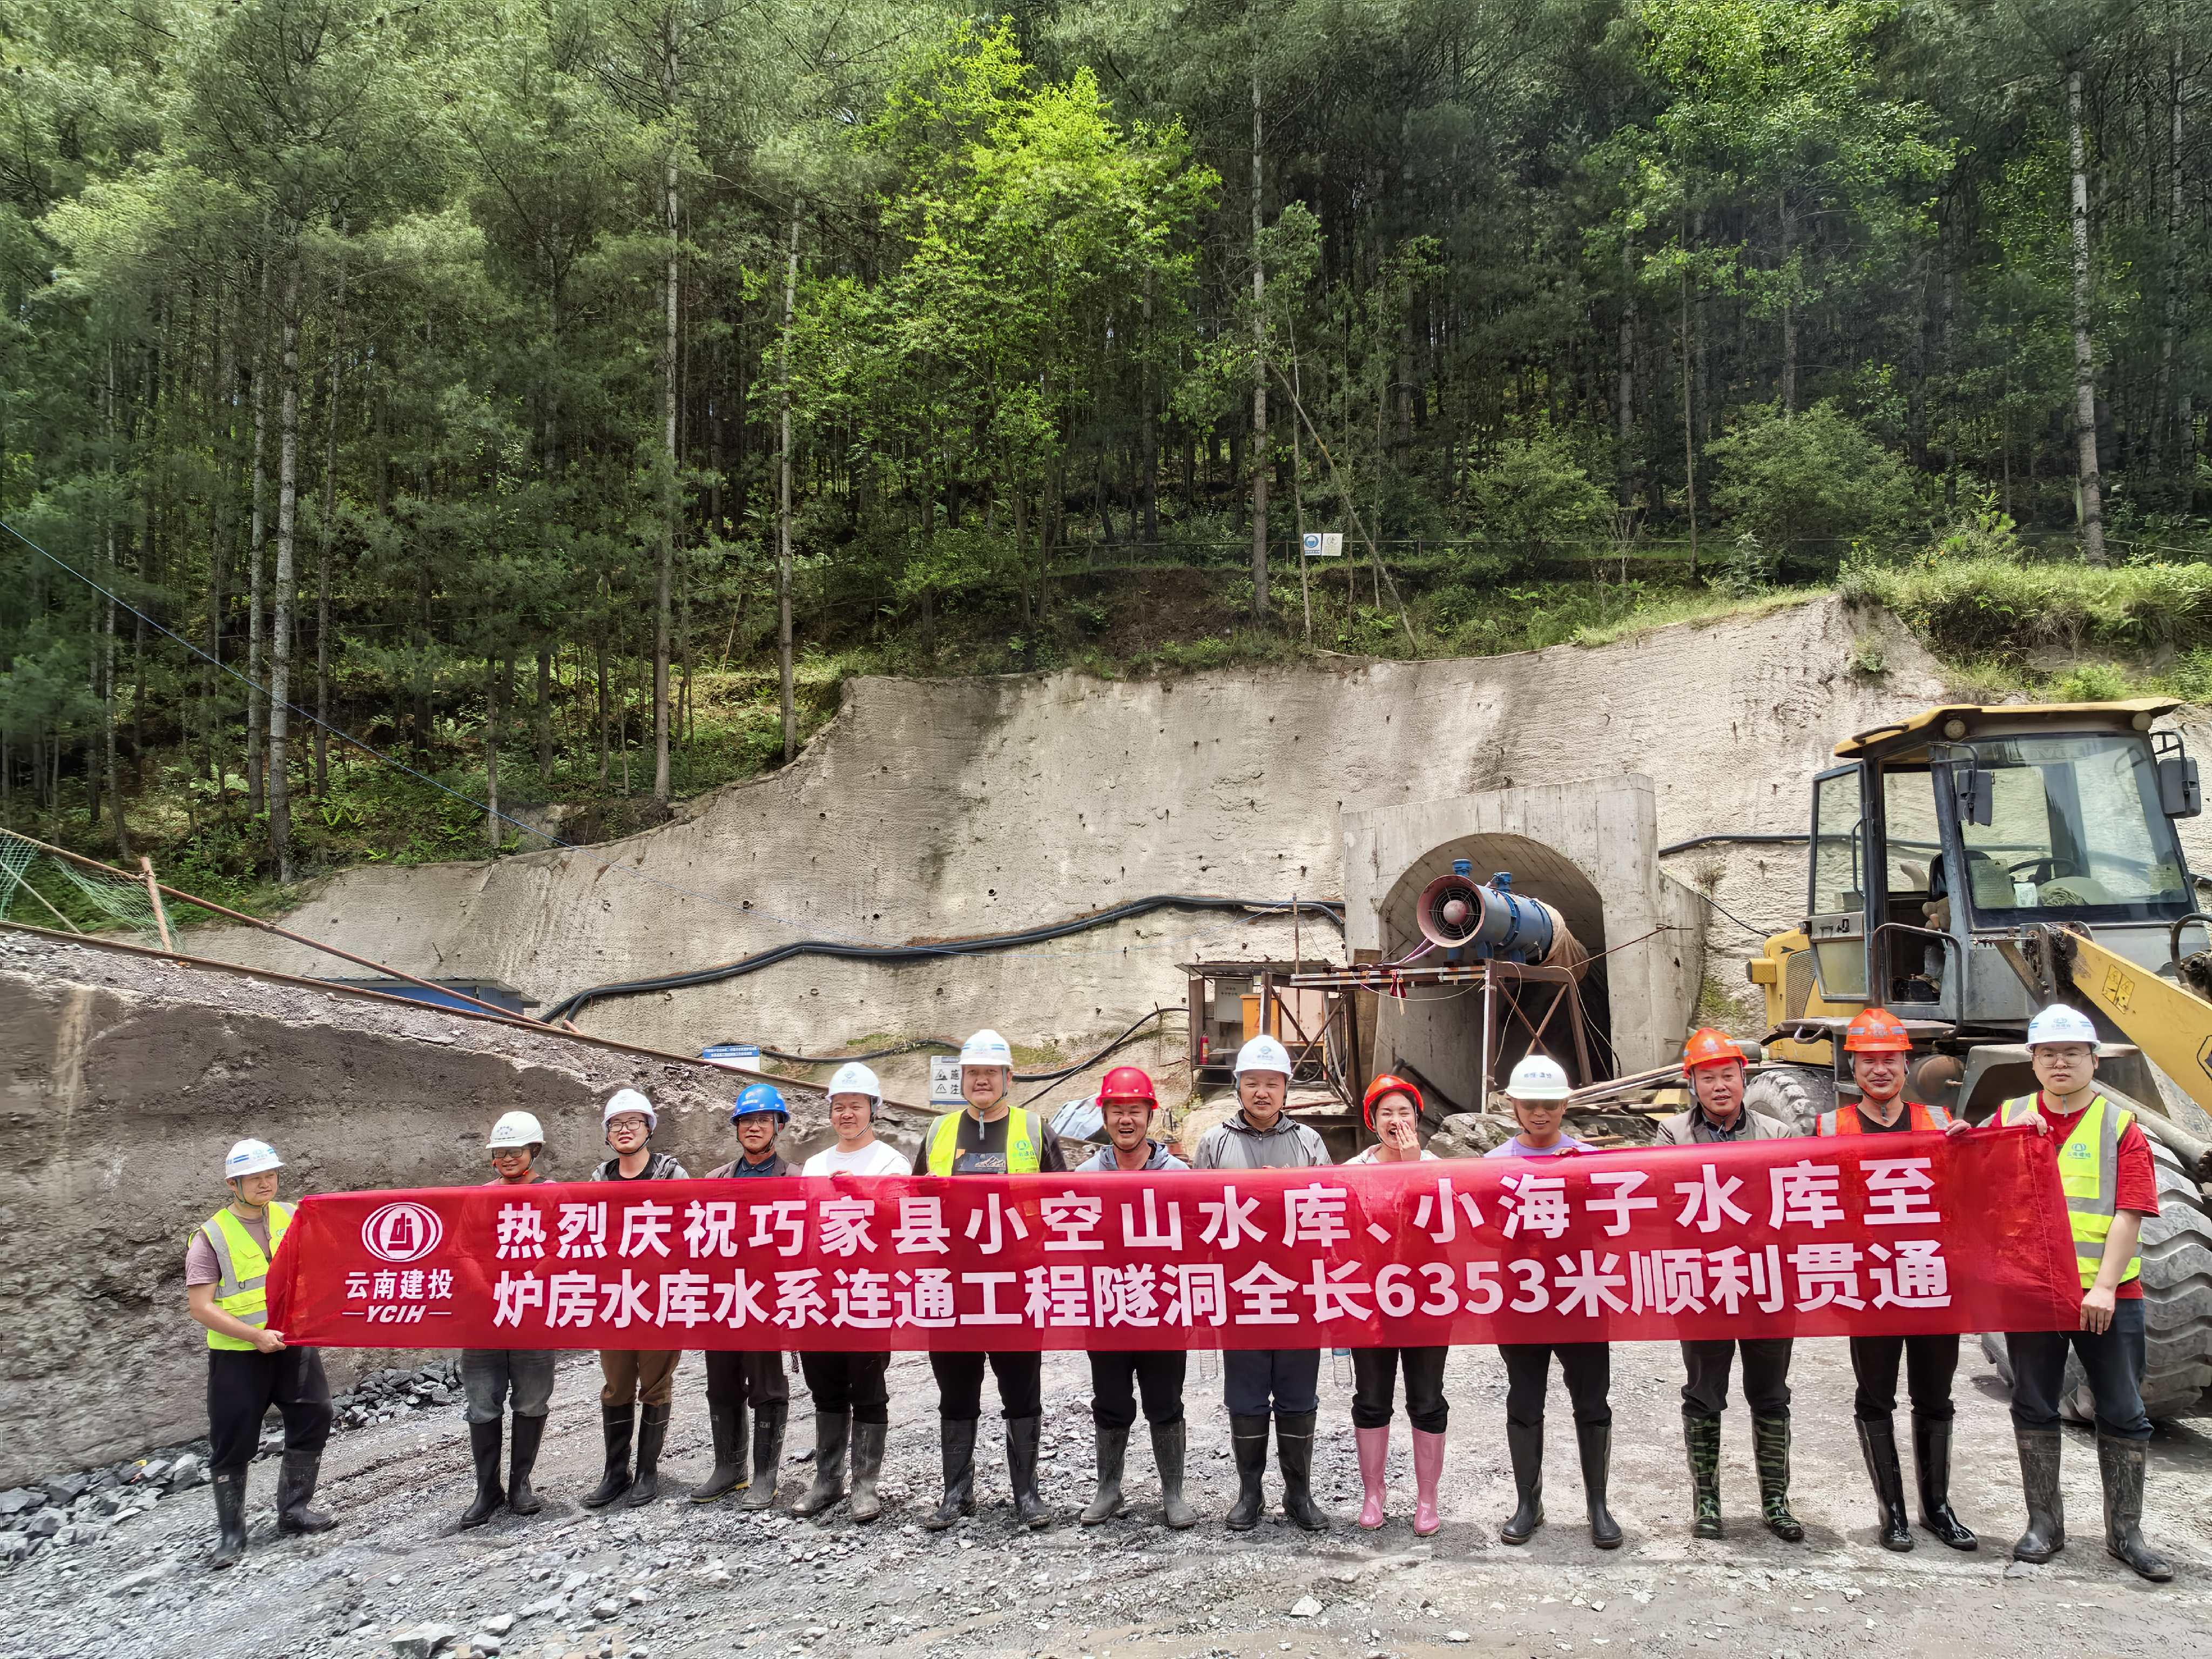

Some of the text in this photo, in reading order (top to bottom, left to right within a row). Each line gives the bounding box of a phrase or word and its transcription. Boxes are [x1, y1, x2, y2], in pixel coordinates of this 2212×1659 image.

[496, 1158, 1940, 1259] 热烈庆祝巧家县小空山水库、小海子水库至
[345, 1269, 453, 1299] 云南建投
[494, 1240, 1951, 1328] 炉房水库水系连通工程隧洞全长6353米顺利贯通
[367, 1305, 426, 1323] YCIH
